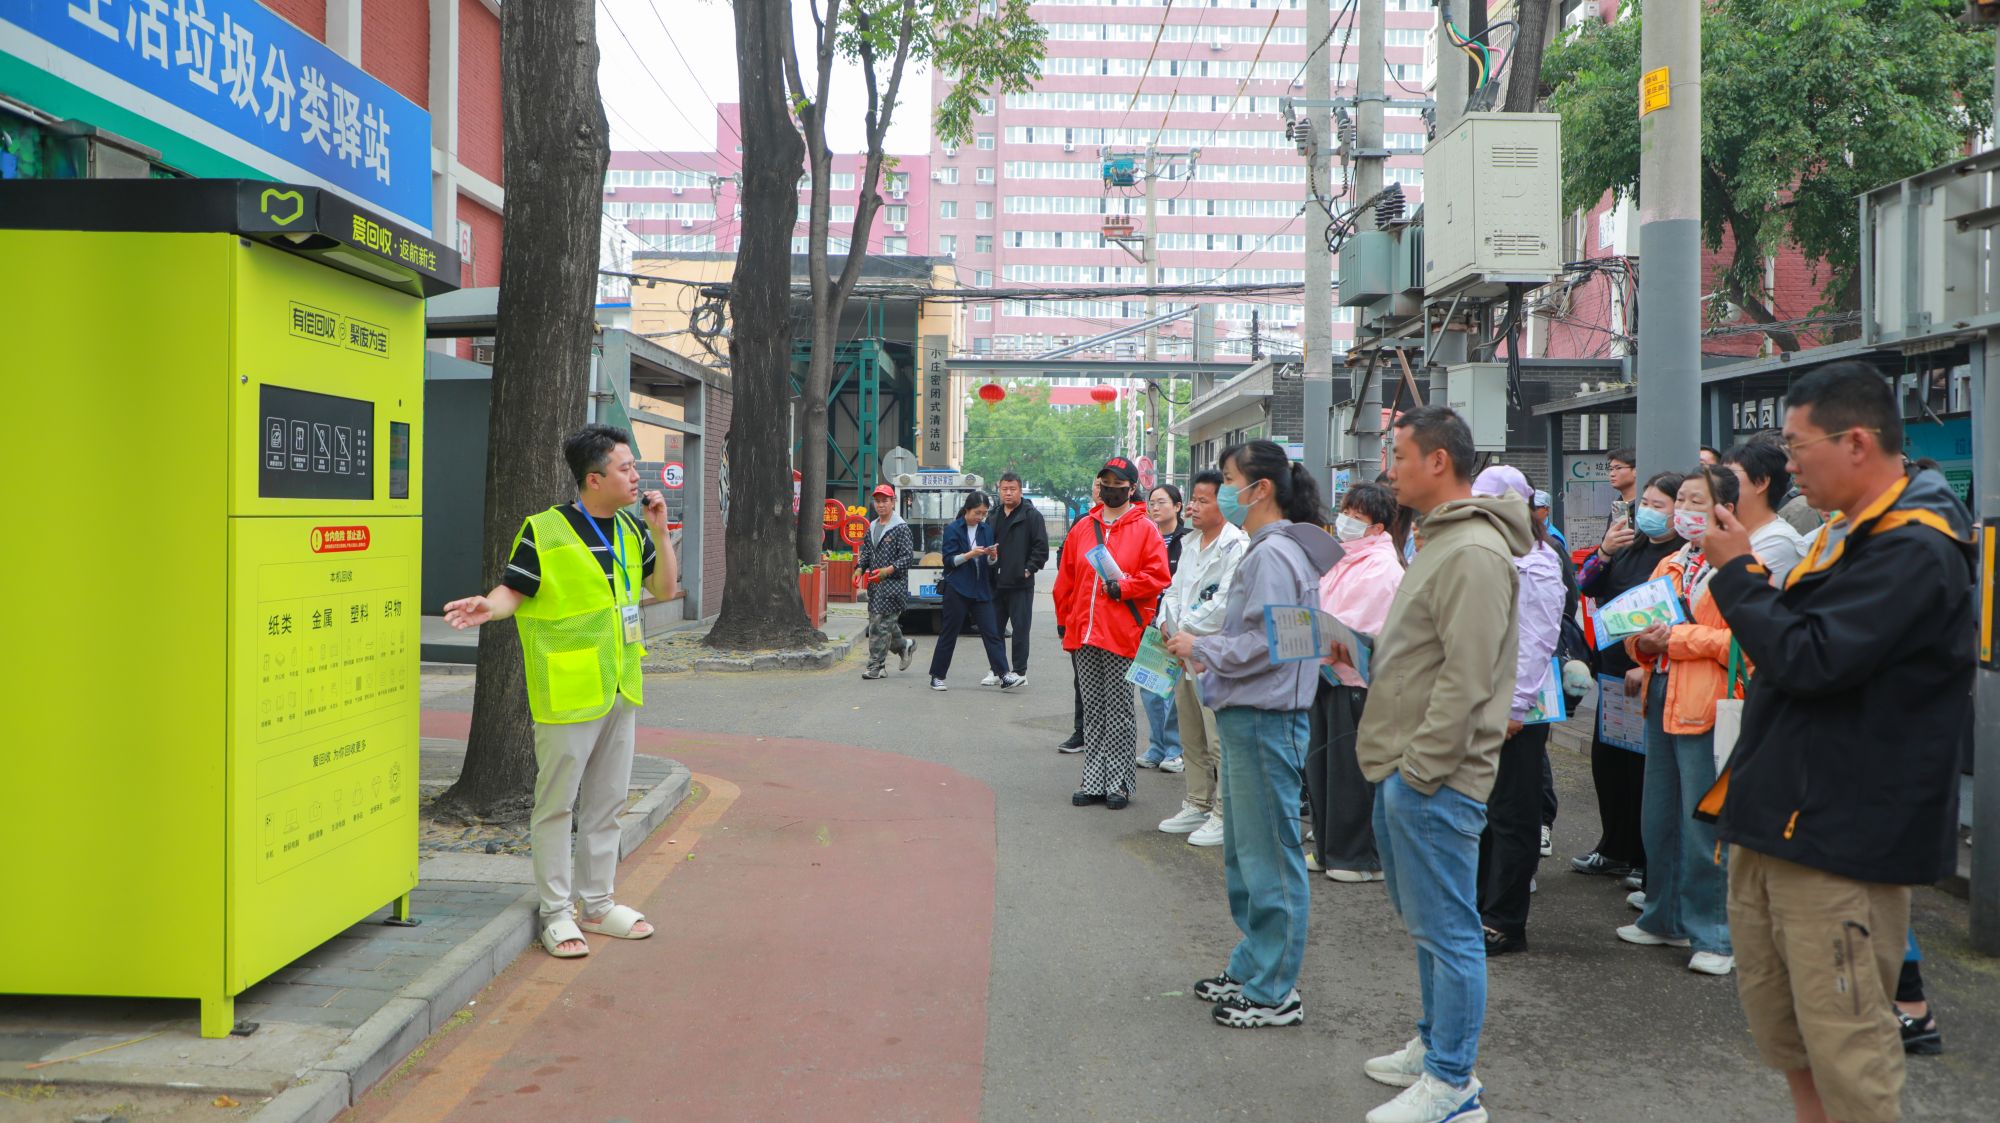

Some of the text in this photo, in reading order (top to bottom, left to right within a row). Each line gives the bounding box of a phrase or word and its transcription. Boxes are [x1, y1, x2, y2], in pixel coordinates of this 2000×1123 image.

[293, 307, 387, 353] 有偿回收 聚废为宝
[929, 348, 942, 453] 小庄密闭式清洁站
[666, 468, 675, 481] 5
[849, 523, 865, 531] 爱国
[329, 570, 353, 583] 本机回收
[268, 599, 402, 636] 纸类 金属 塑料 织物
